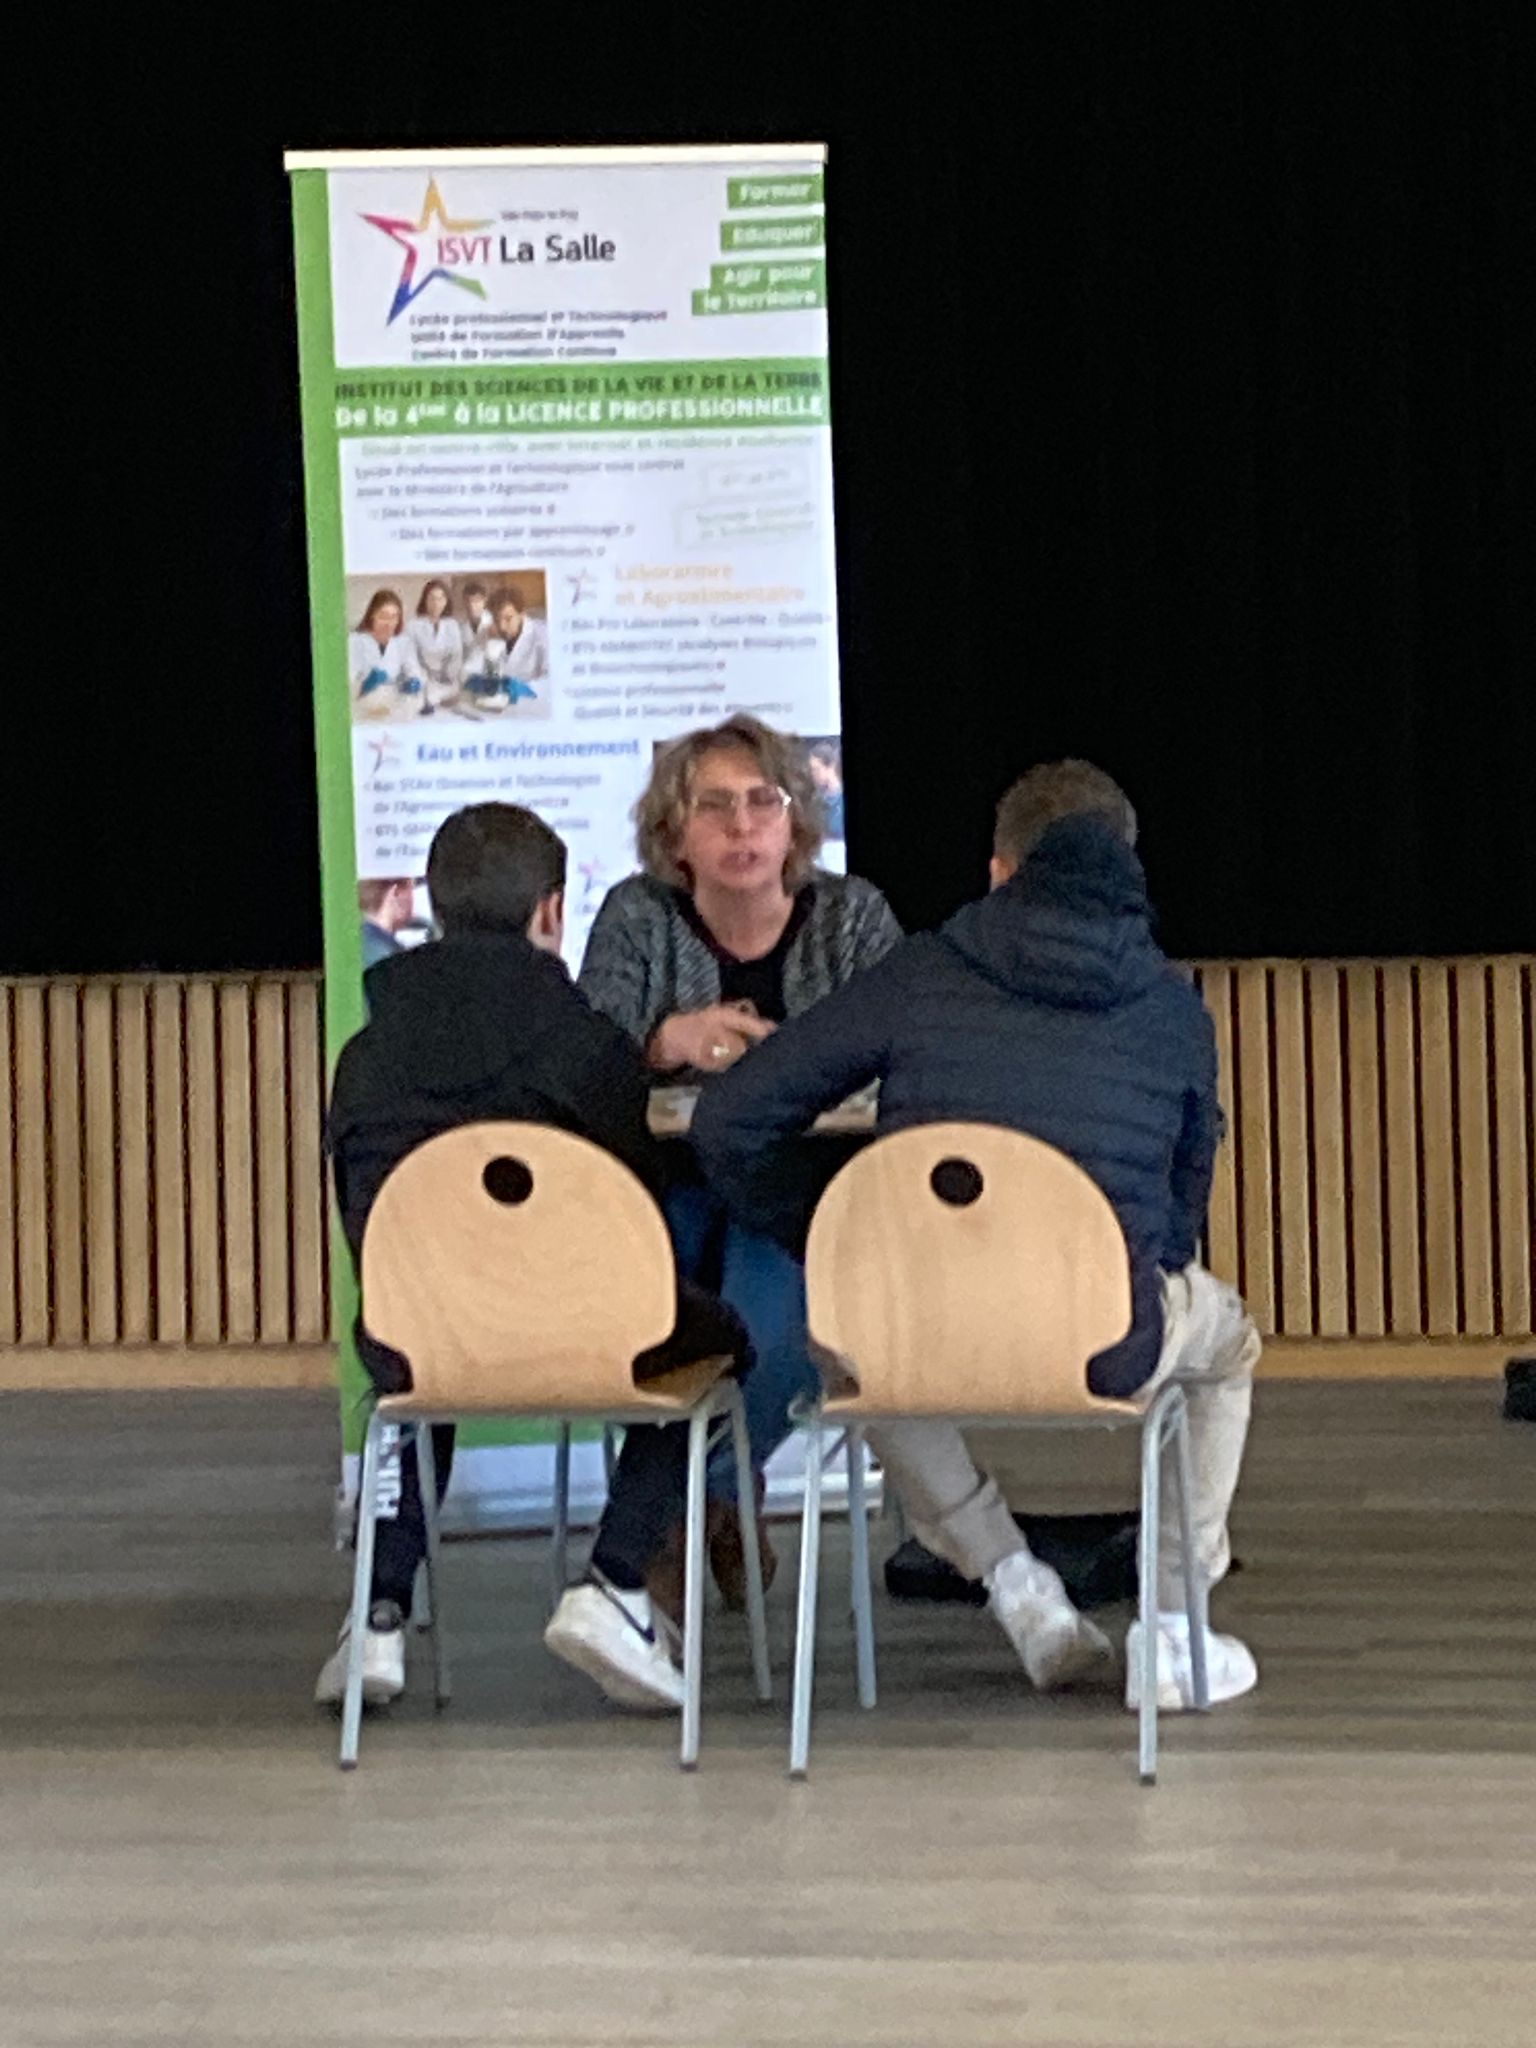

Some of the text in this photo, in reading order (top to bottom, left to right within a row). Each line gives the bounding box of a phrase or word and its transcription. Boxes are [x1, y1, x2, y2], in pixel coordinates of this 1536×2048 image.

[437, 233, 617, 264] ISVT La Salle
[431, 379, 468, 396] DES
[474, 378, 567, 396] SCIENCES
[572, 377, 599, 394] DE
[604, 377, 630, 392] LA
[634, 375, 664, 391] VIE
[672, 374, 695, 391] ET
[701, 374, 726, 390] DE
[732, 373, 757, 389] LA
[335, 405, 368, 428] De
[374, 405, 398, 427] la
[476, 402, 500, 424] la
[506, 400, 602, 424] LICENCE
[608, 395, 823, 422] PROFESSIONNELLE
[416, 739, 640, 762] Eau et Environnement
